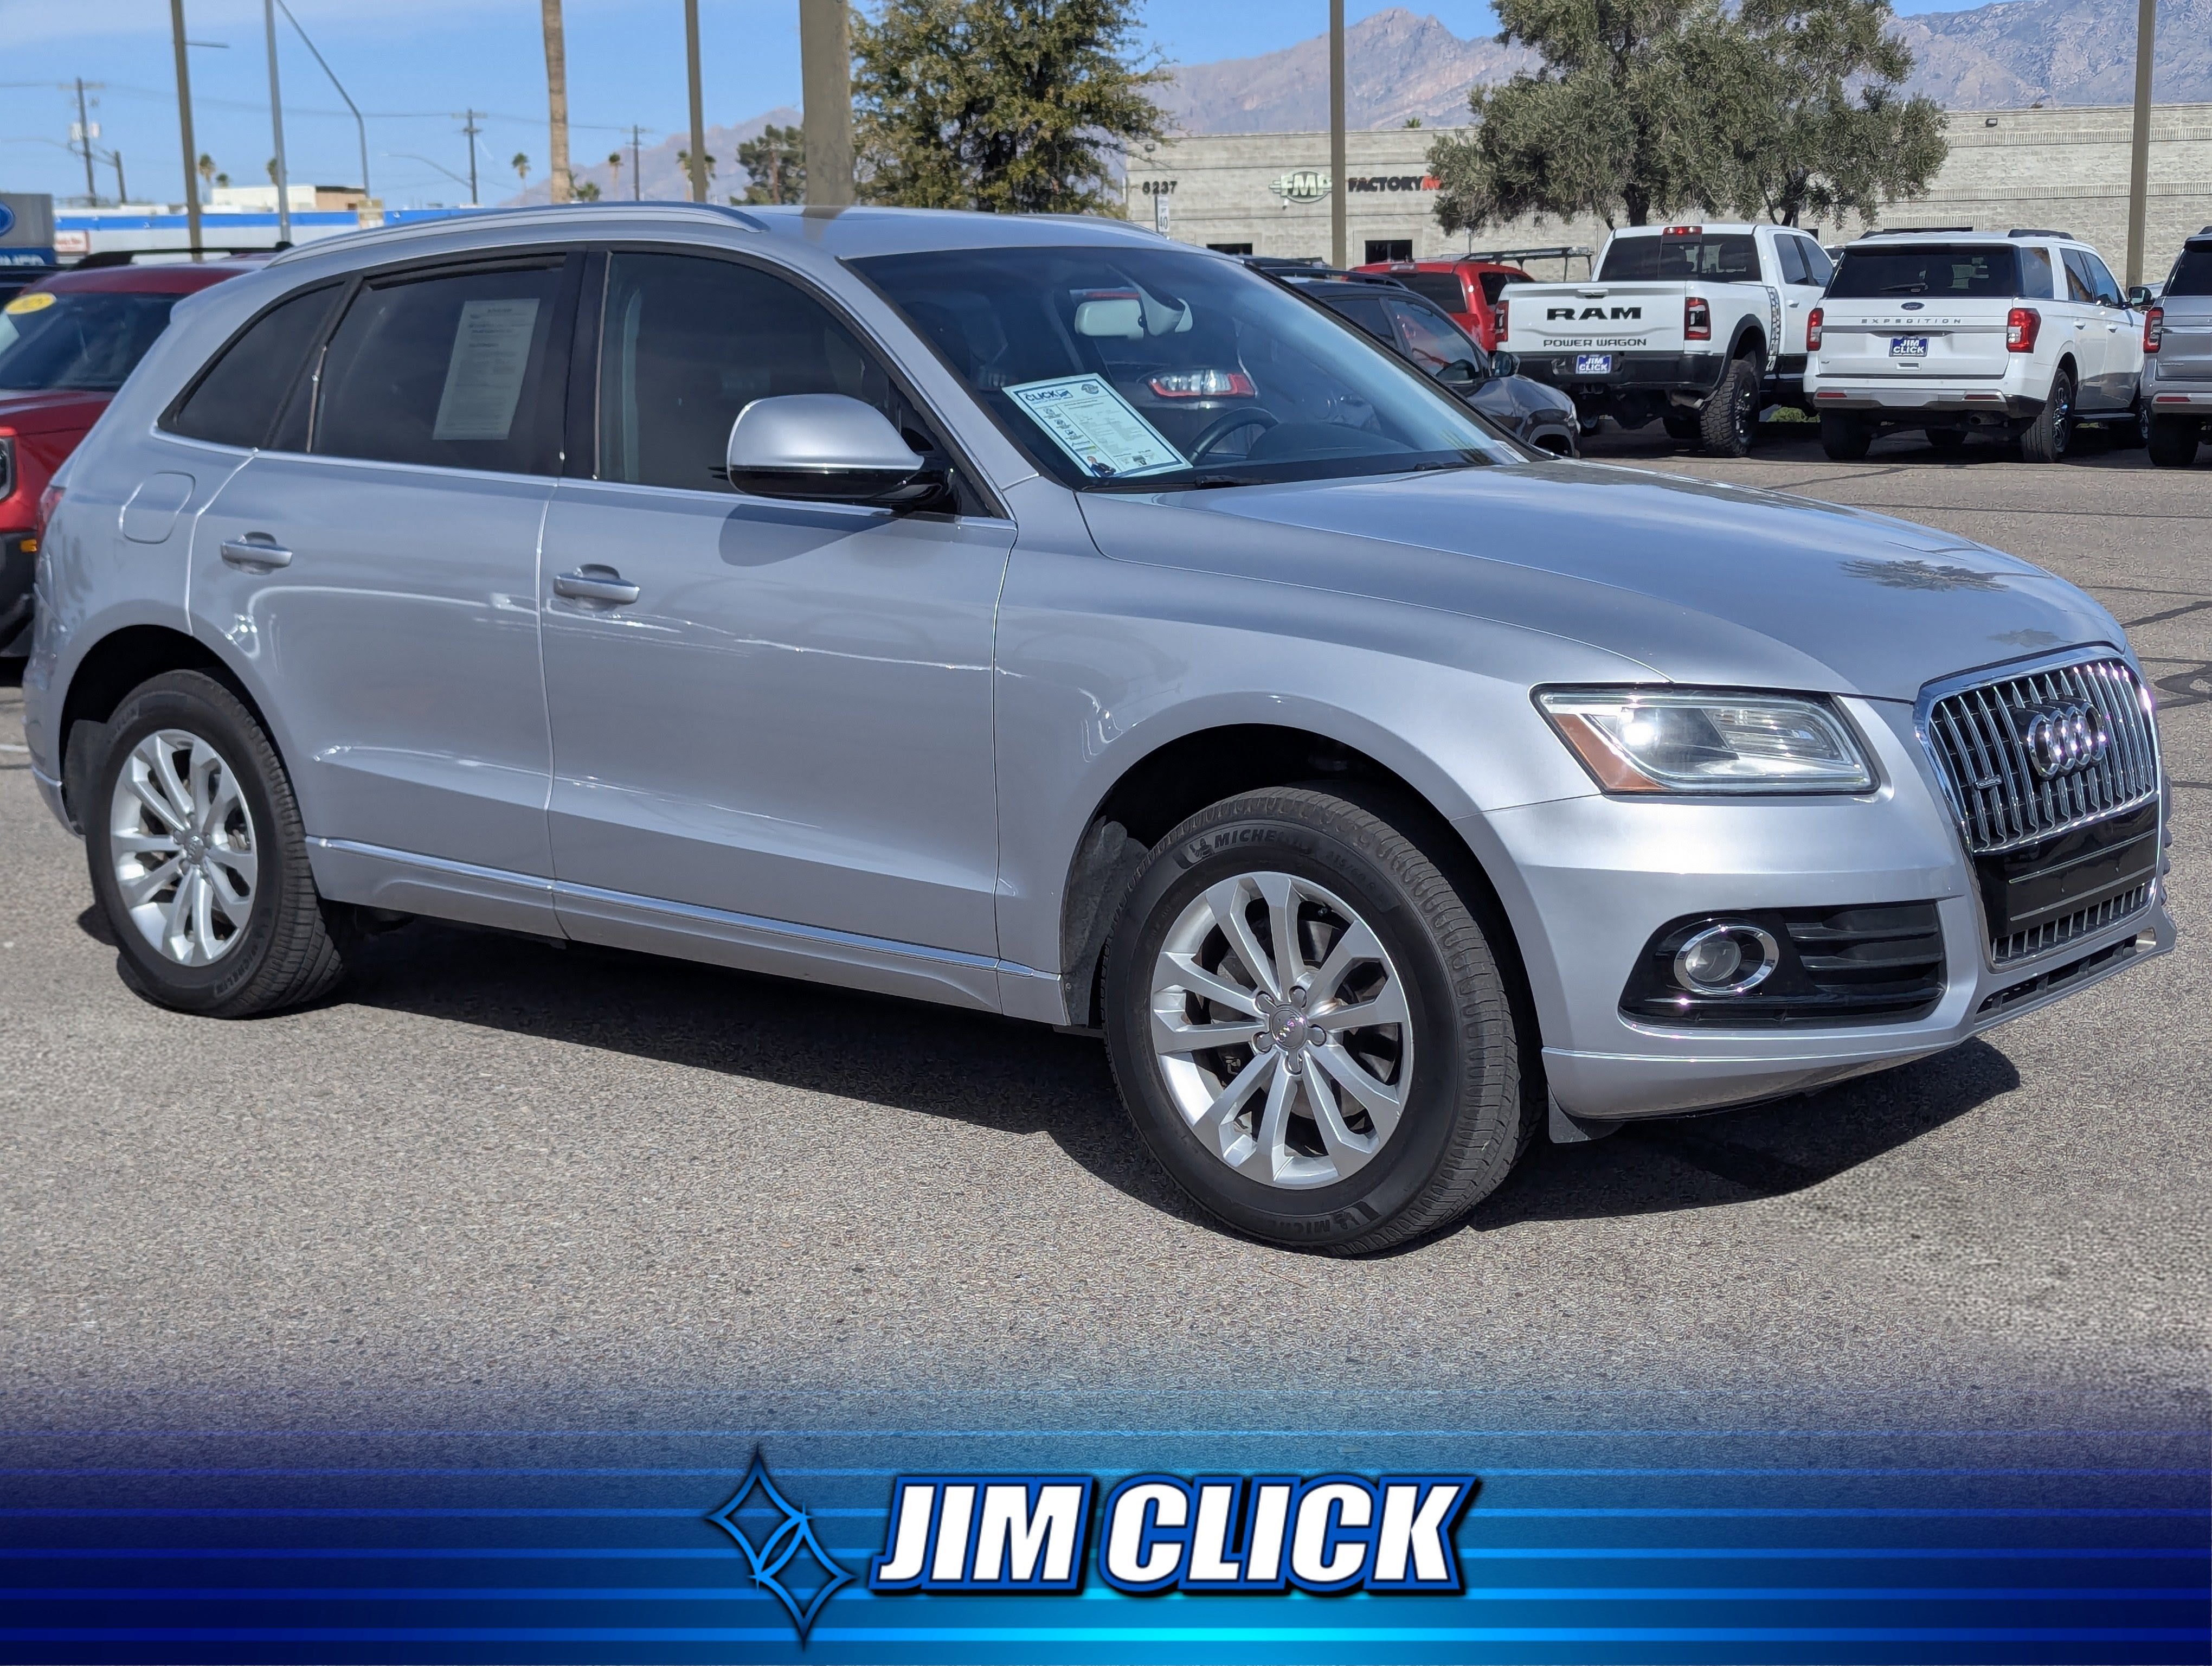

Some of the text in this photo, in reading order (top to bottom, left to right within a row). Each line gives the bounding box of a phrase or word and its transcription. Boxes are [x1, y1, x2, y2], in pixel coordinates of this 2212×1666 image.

[1547, 307, 1642, 321] RAM
[1544, 338, 1647, 347] POWER WAGON
[1025, 390, 1059, 401] CLICK
